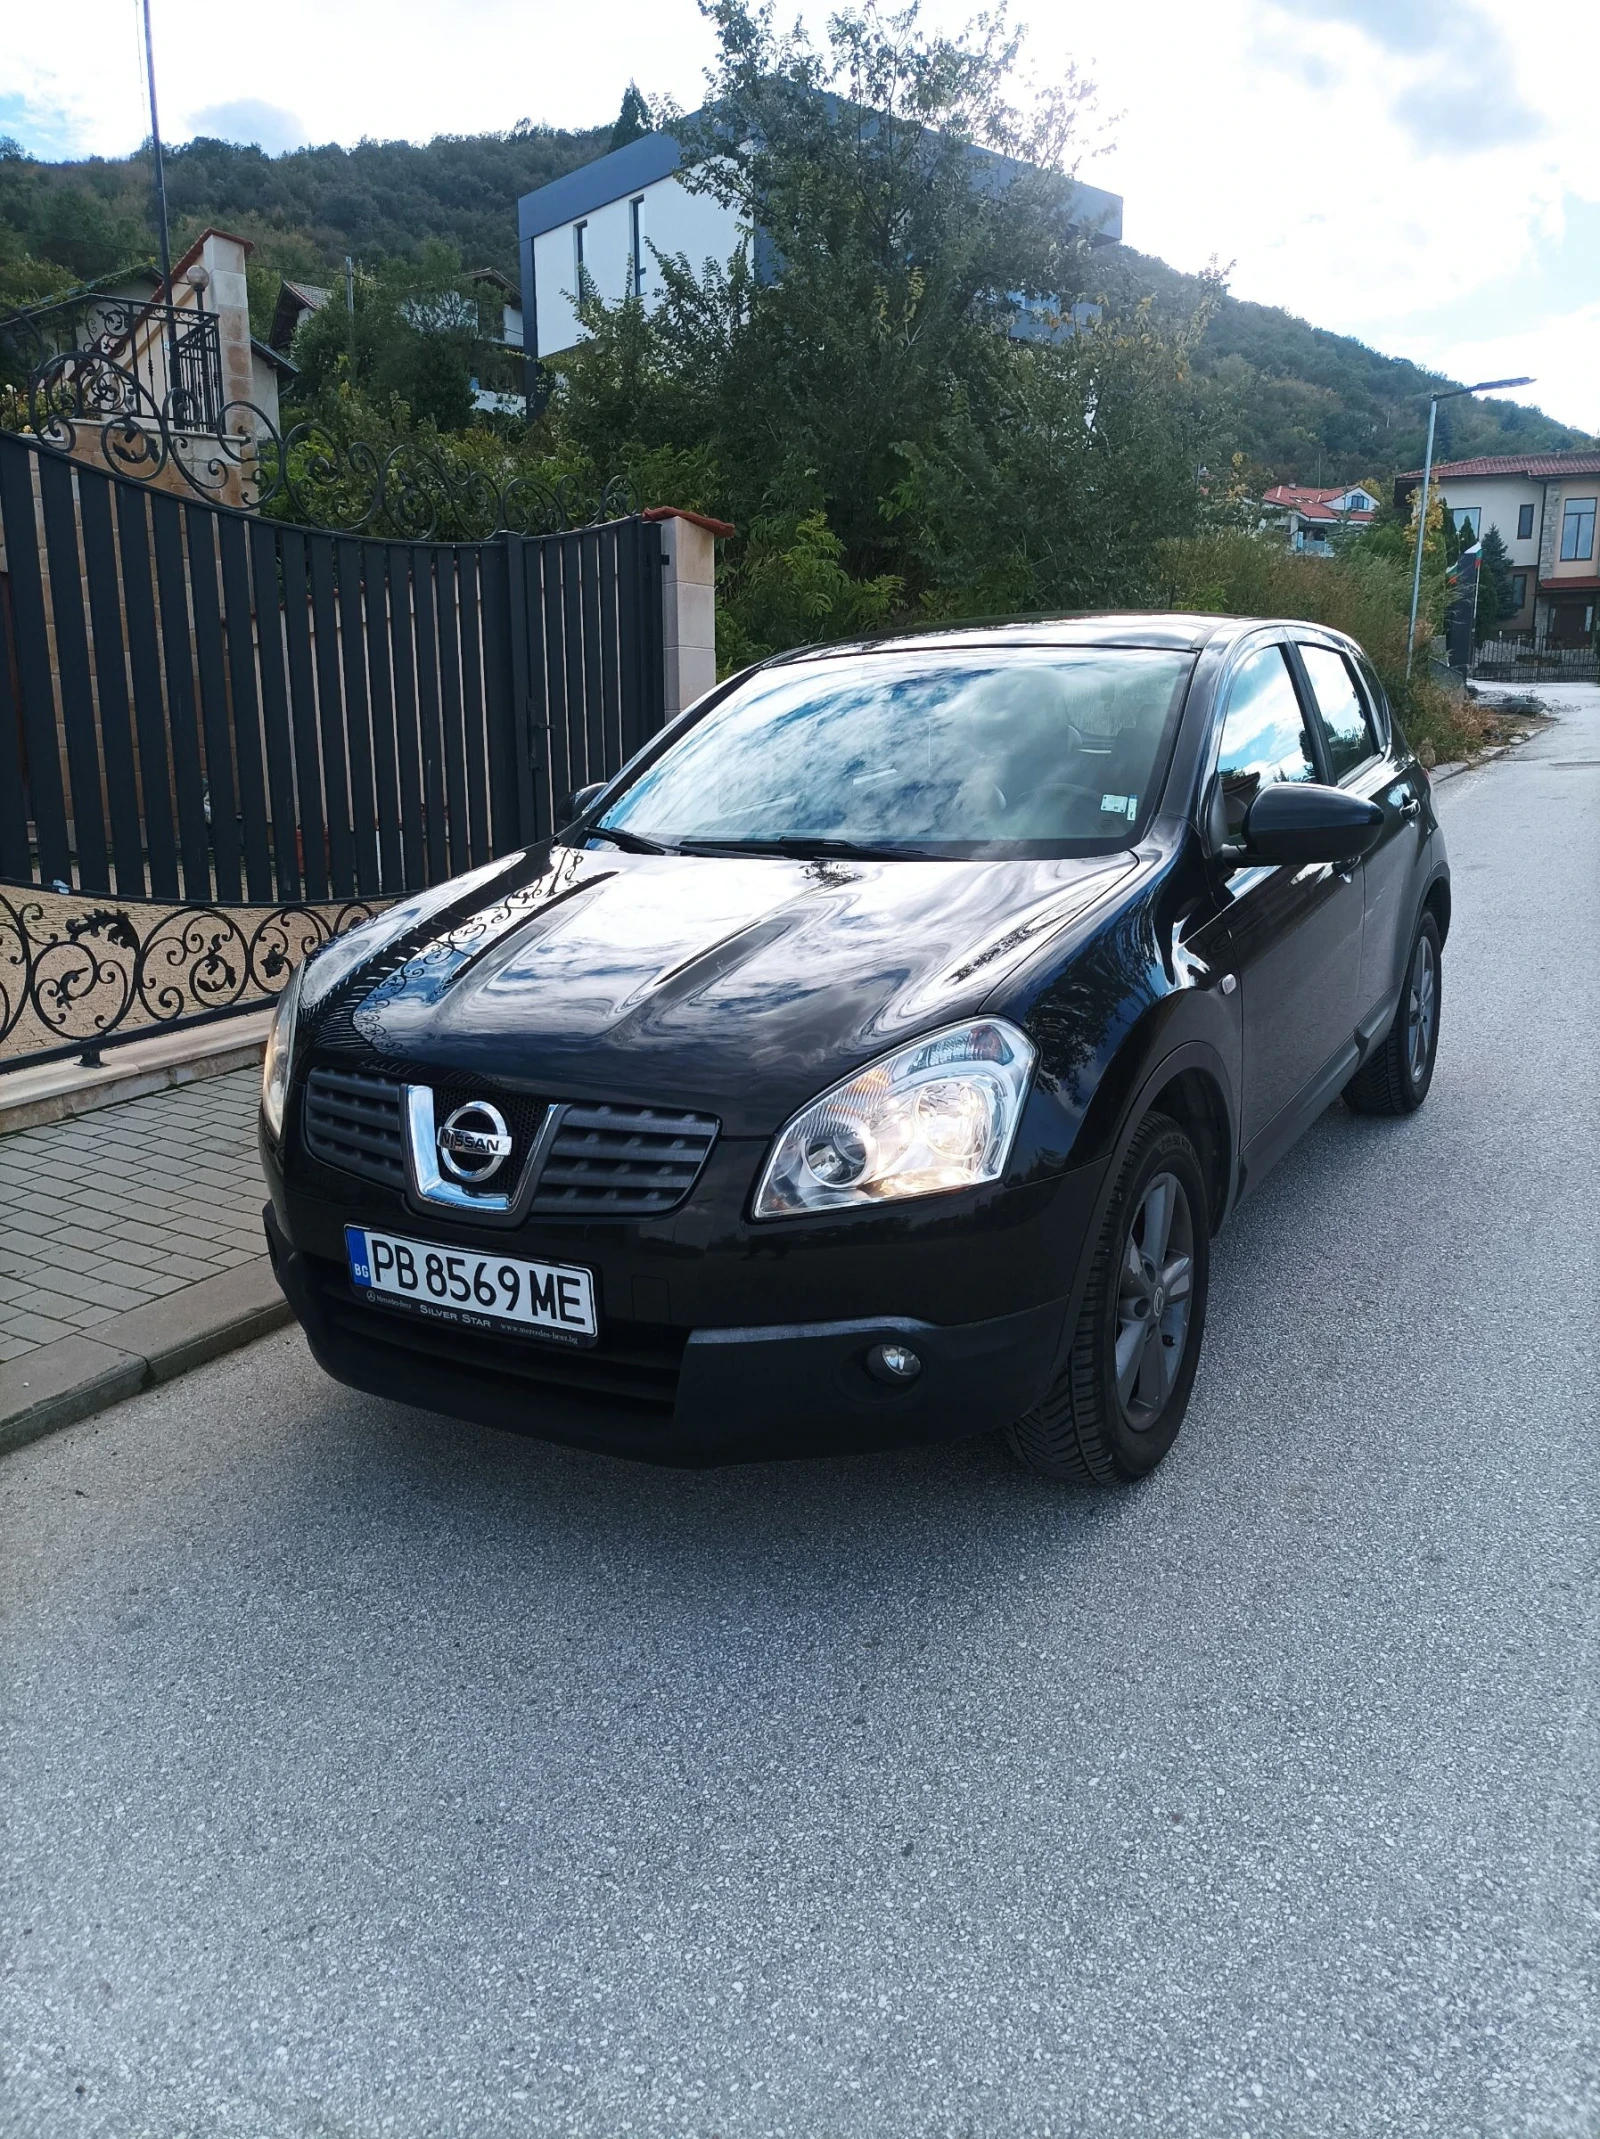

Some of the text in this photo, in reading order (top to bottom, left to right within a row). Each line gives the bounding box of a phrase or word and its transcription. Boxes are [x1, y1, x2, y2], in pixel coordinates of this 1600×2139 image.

[441, 1132, 500, 1152] NISSAN
[354, 1263, 370, 1278] BG
[371, 1239, 586, 1325] PB 8569 ME
[500, 1323, 578, 1344] www.mercedes-benz.bg
